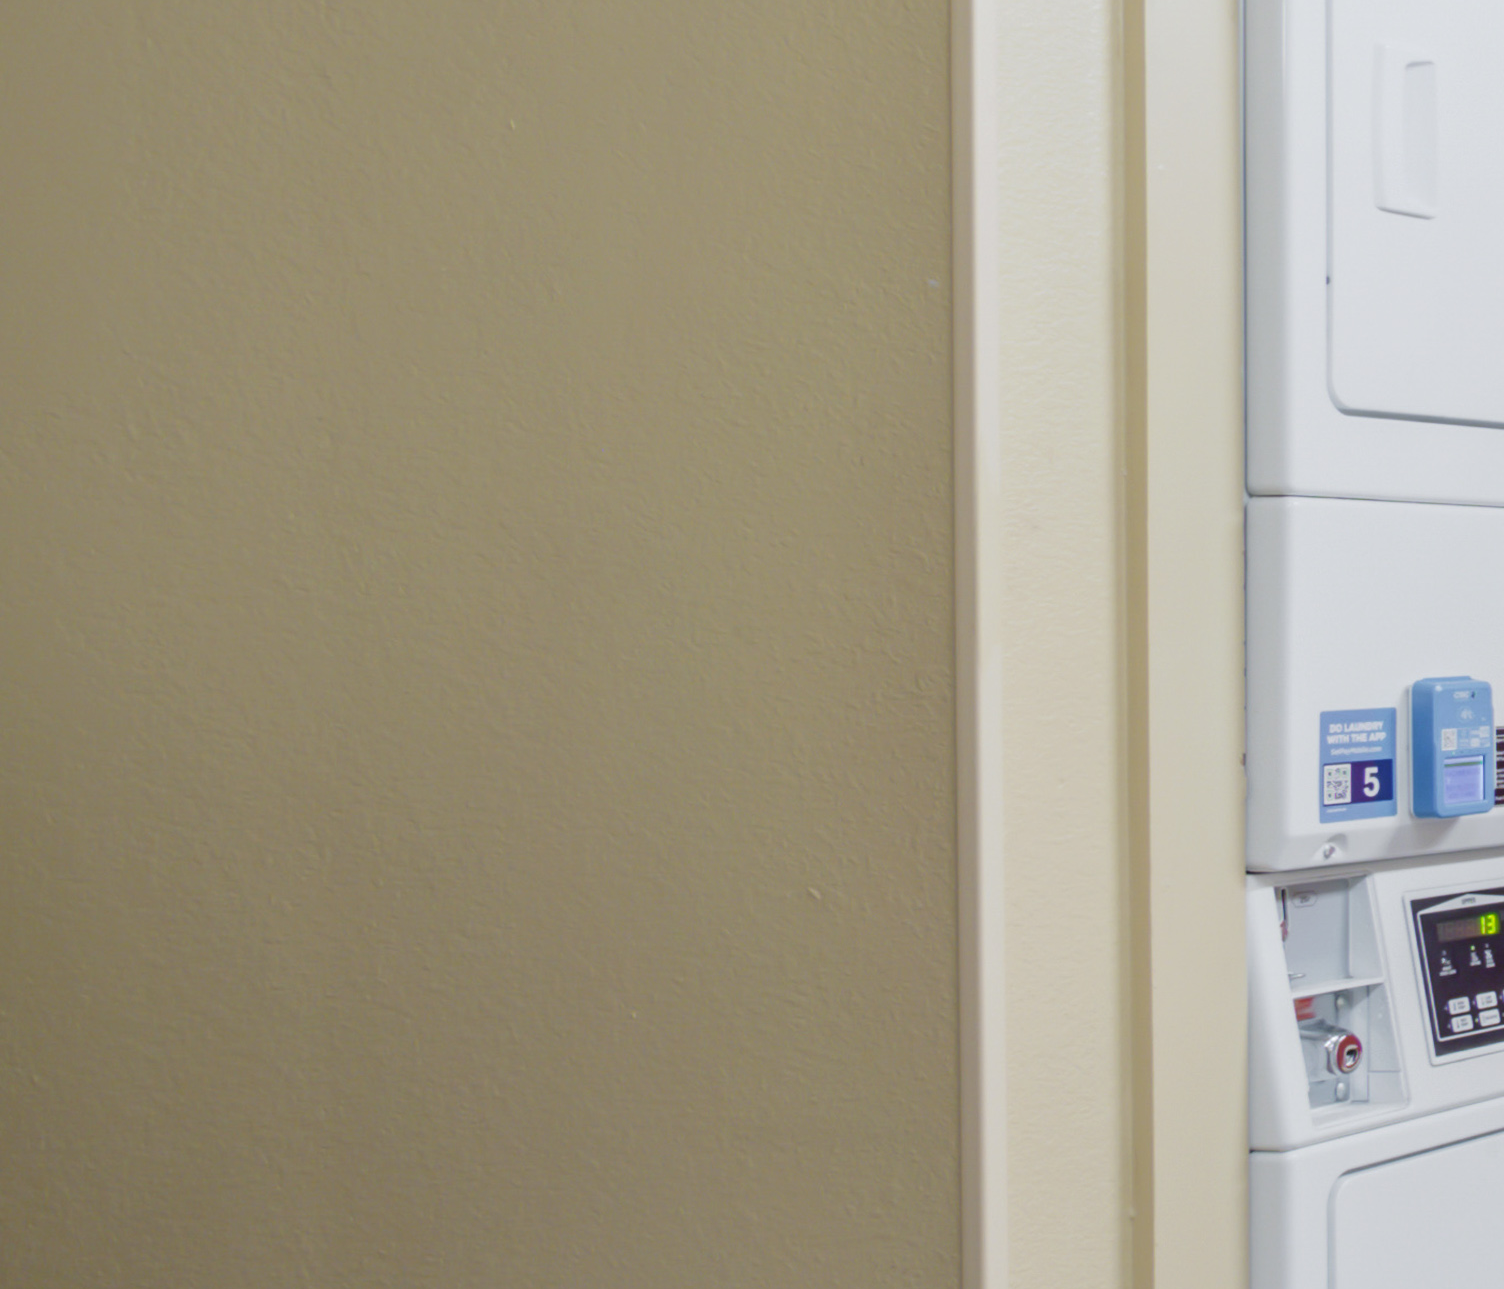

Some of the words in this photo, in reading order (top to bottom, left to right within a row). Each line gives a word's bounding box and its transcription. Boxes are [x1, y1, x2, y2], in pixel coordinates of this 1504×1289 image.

[1344, 721, 1384, 732] LAUNDRY
[1326, 734, 1350, 745] WITH
[1351, 732, 1368, 743] THE
[1369, 731, 1387, 742] APP
[1363, 766, 1380, 798] 5
[1480, 914, 1496, 935] 13
